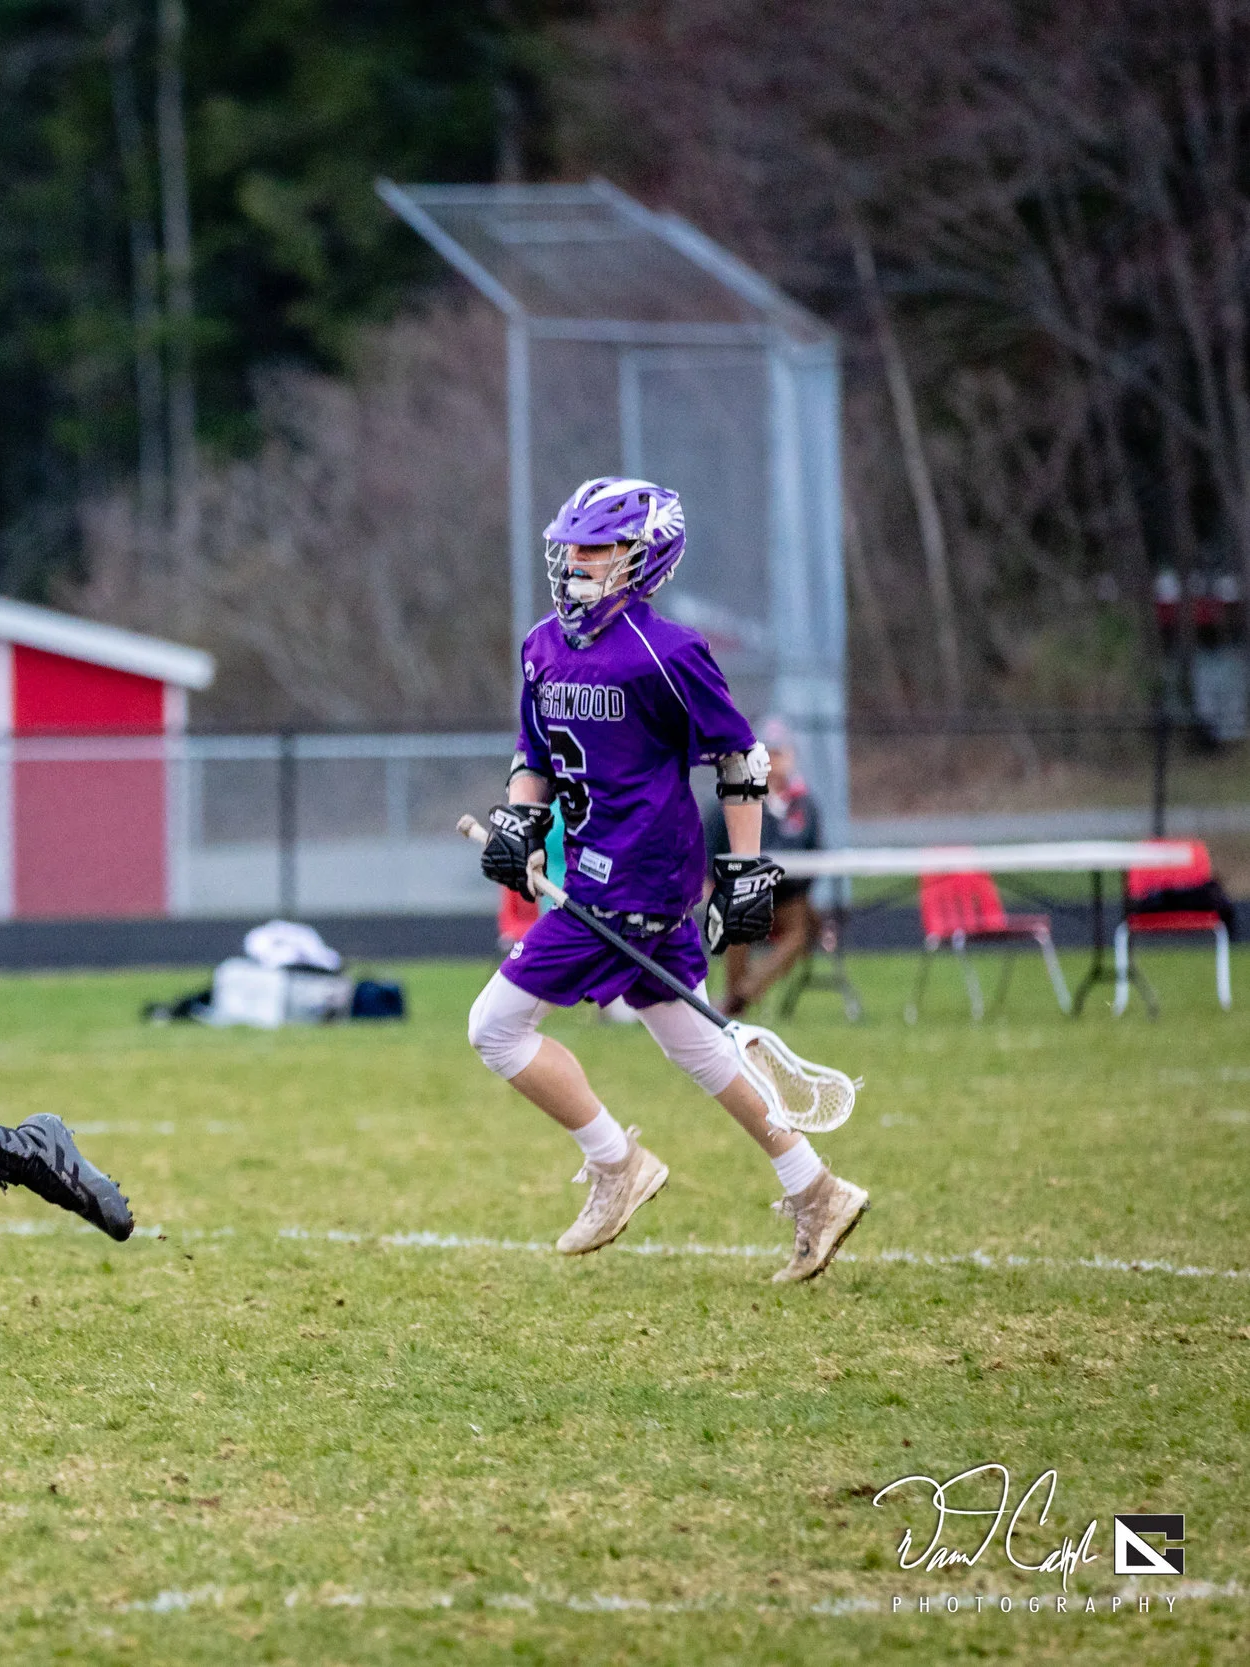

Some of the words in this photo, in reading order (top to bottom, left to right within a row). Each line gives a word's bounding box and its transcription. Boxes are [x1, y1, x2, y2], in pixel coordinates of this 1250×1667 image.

[538, 681, 626, 722] SHWOOD
[490, 808, 532, 837] STX
[732, 868, 779, 897] STX
